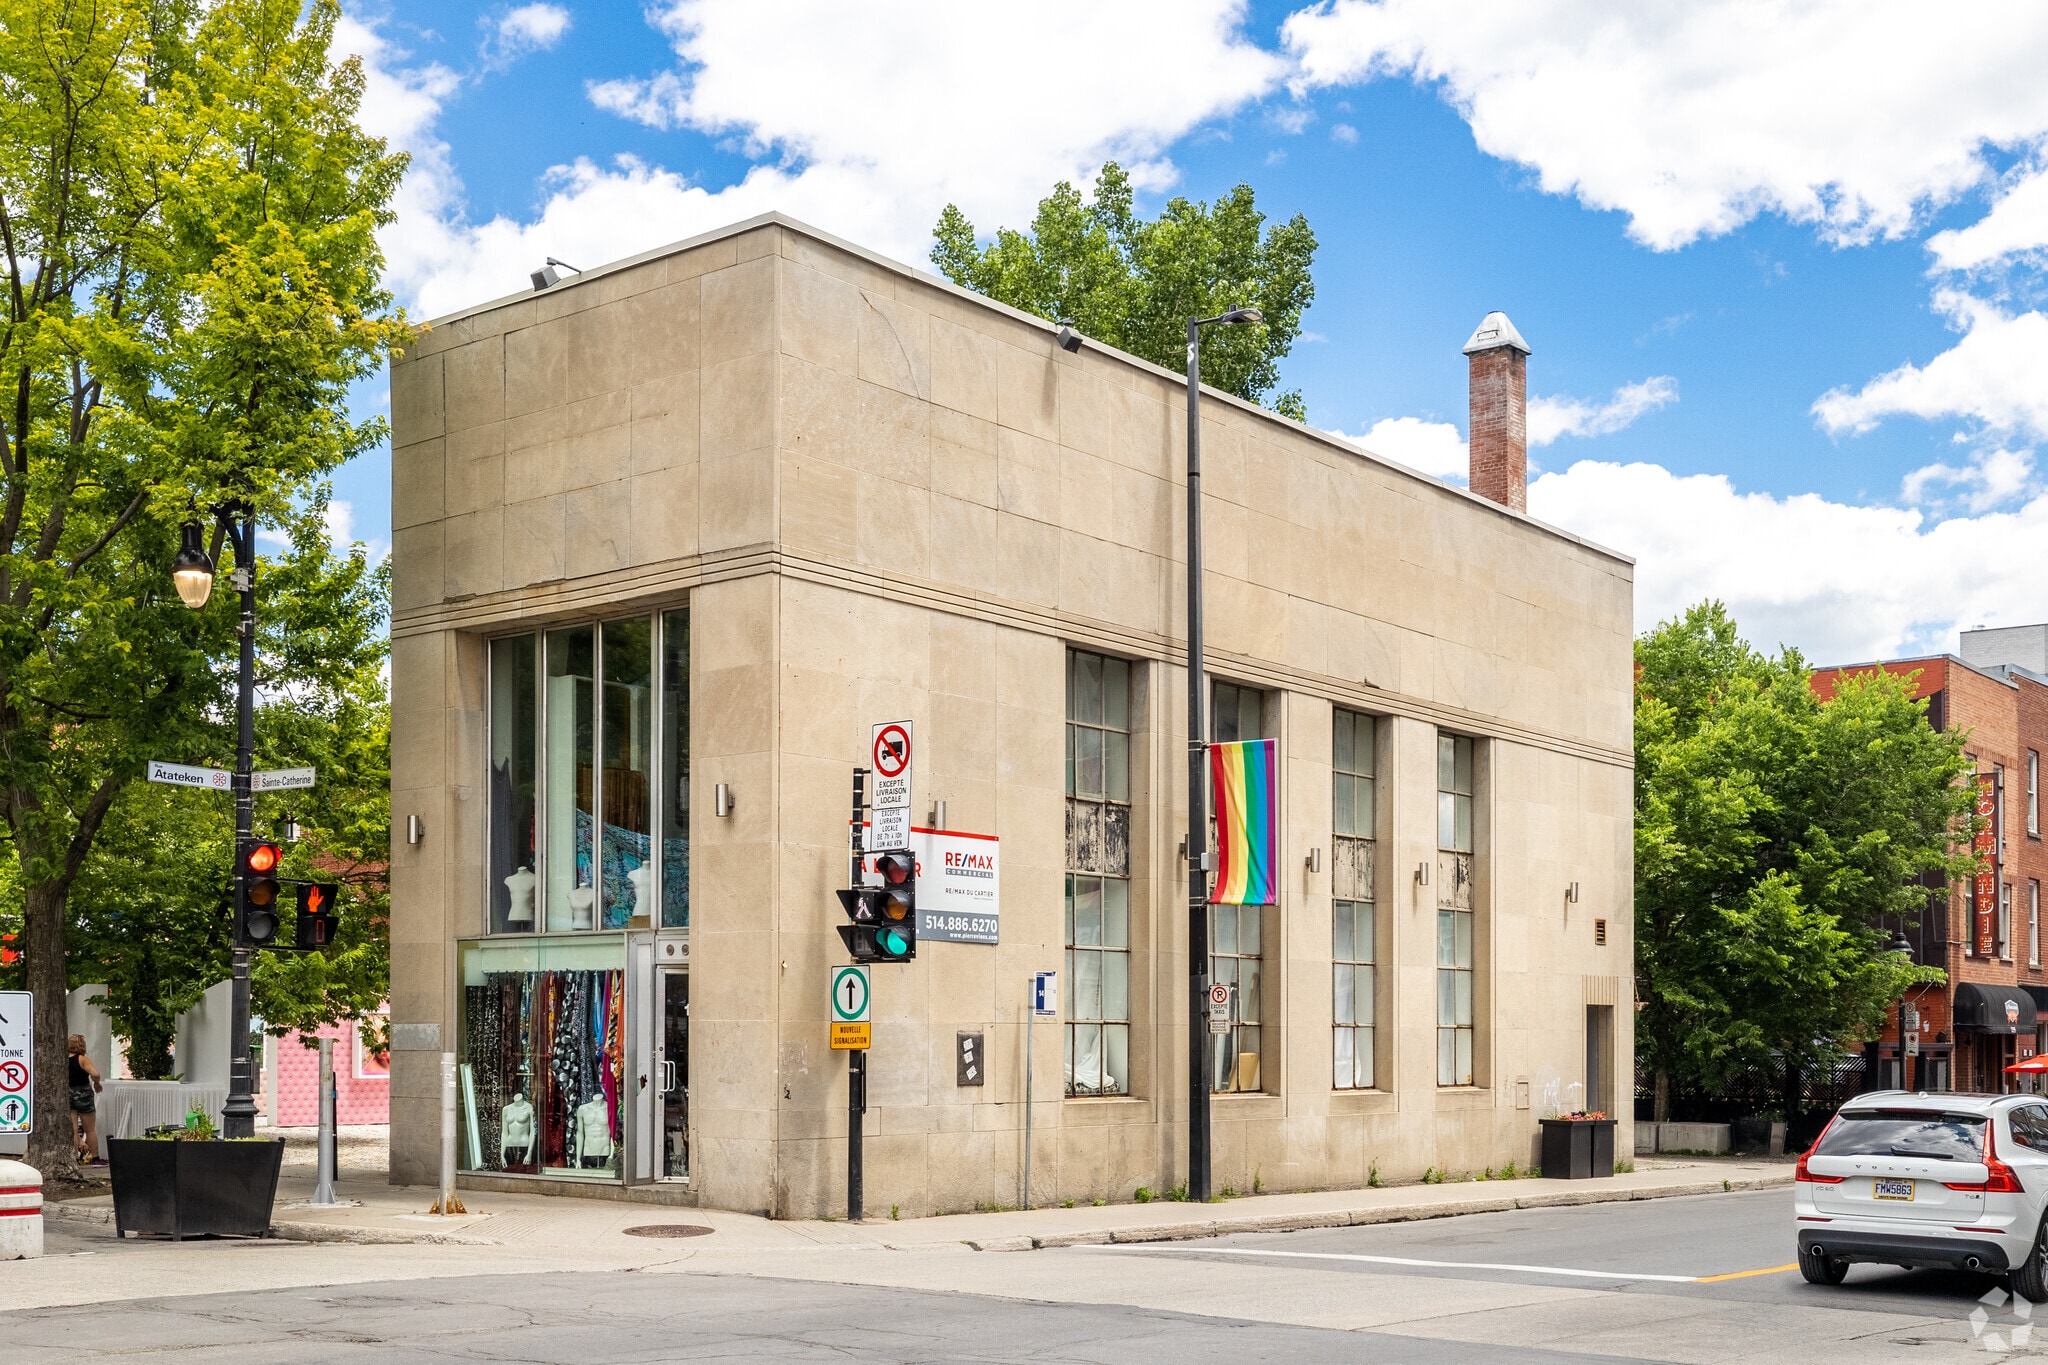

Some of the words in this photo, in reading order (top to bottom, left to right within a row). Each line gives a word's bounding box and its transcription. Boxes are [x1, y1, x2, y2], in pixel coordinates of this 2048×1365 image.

[154, 769, 204, 784] Atateken
[262, 774, 312, 787] Sainte-Catherine
[876, 787, 907, 796] LIVRAISON
[880, 796, 902, 804] LOCALE
[880, 817, 902, 825] LIVRAISON
[894, 839, 902, 847] VEN
[945, 852, 993, 870] RE/MAX
[946, 869, 993, 878] COMMERCIAL
[945, 887, 965, 895] RE/MAX
[925, 915, 998, 933] 514.886.6270
[840, 1026, 861, 1034] NOUVELLE
[834, 1036, 867, 1045] SIGNALISATION
[1855, 1164, 1929, 1173] VOLVO
